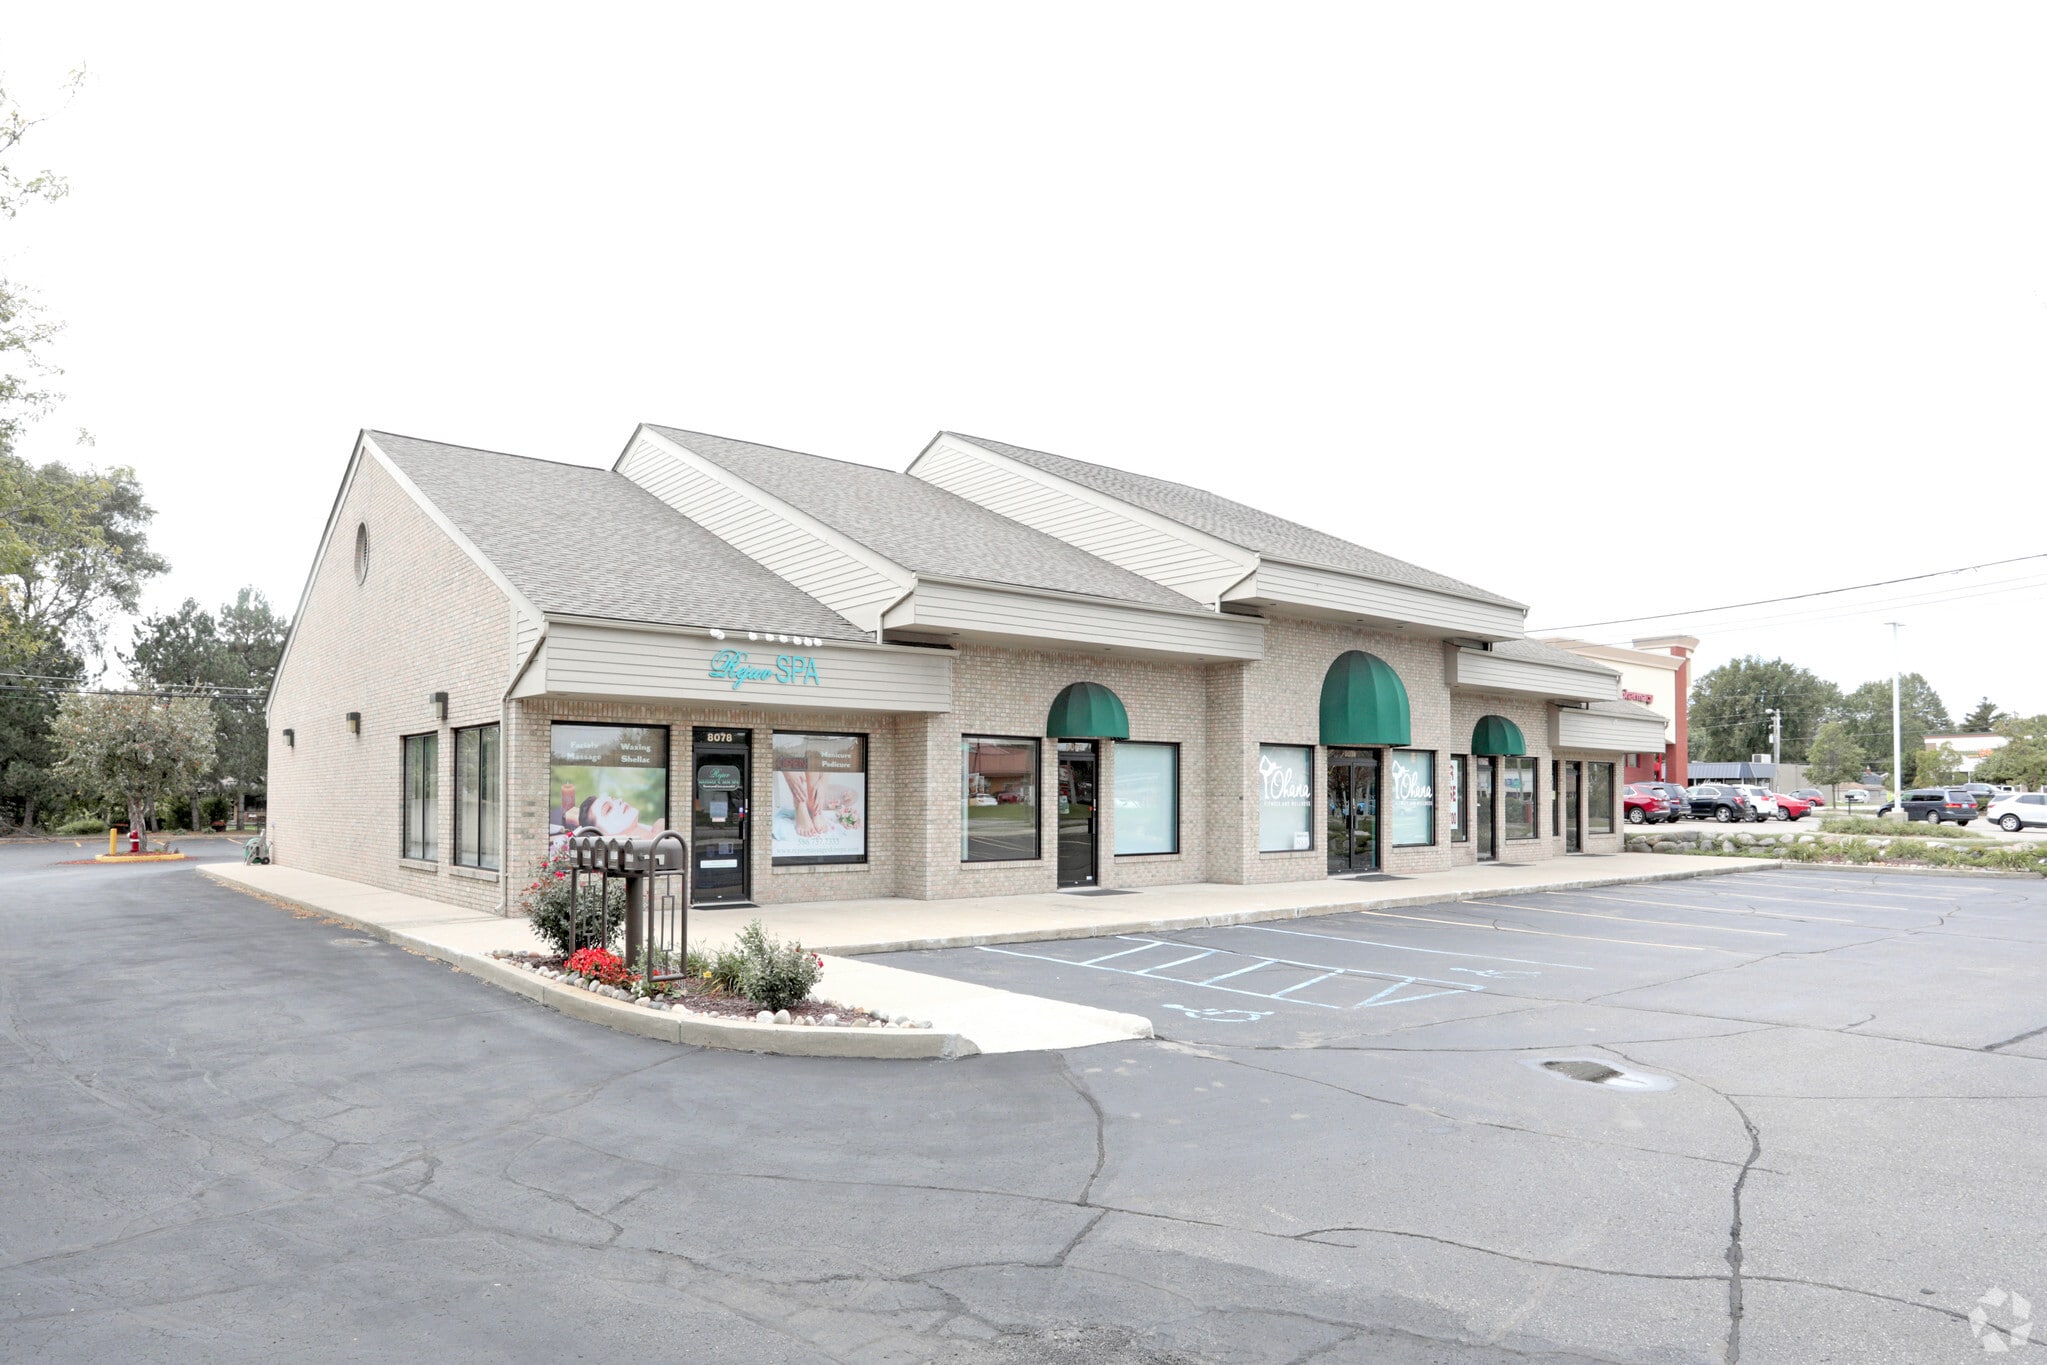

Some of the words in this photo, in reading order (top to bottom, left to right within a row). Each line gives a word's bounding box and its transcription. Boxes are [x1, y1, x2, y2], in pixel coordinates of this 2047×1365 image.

[708, 648, 773, 690] Rejuv
[776, 654, 820, 685] SPA
[707, 732, 733, 742] 8078
[620, 743, 652, 753] Waxing
[566, 752, 602, 763] Massage
[620, 755, 651, 764] Shellac
[821, 751, 852, 760] Manicure
[821, 760, 852, 769] Pedicure
[1270, 767, 1311, 799] Ohana
[1400, 770, 1433, 800] Ohana
